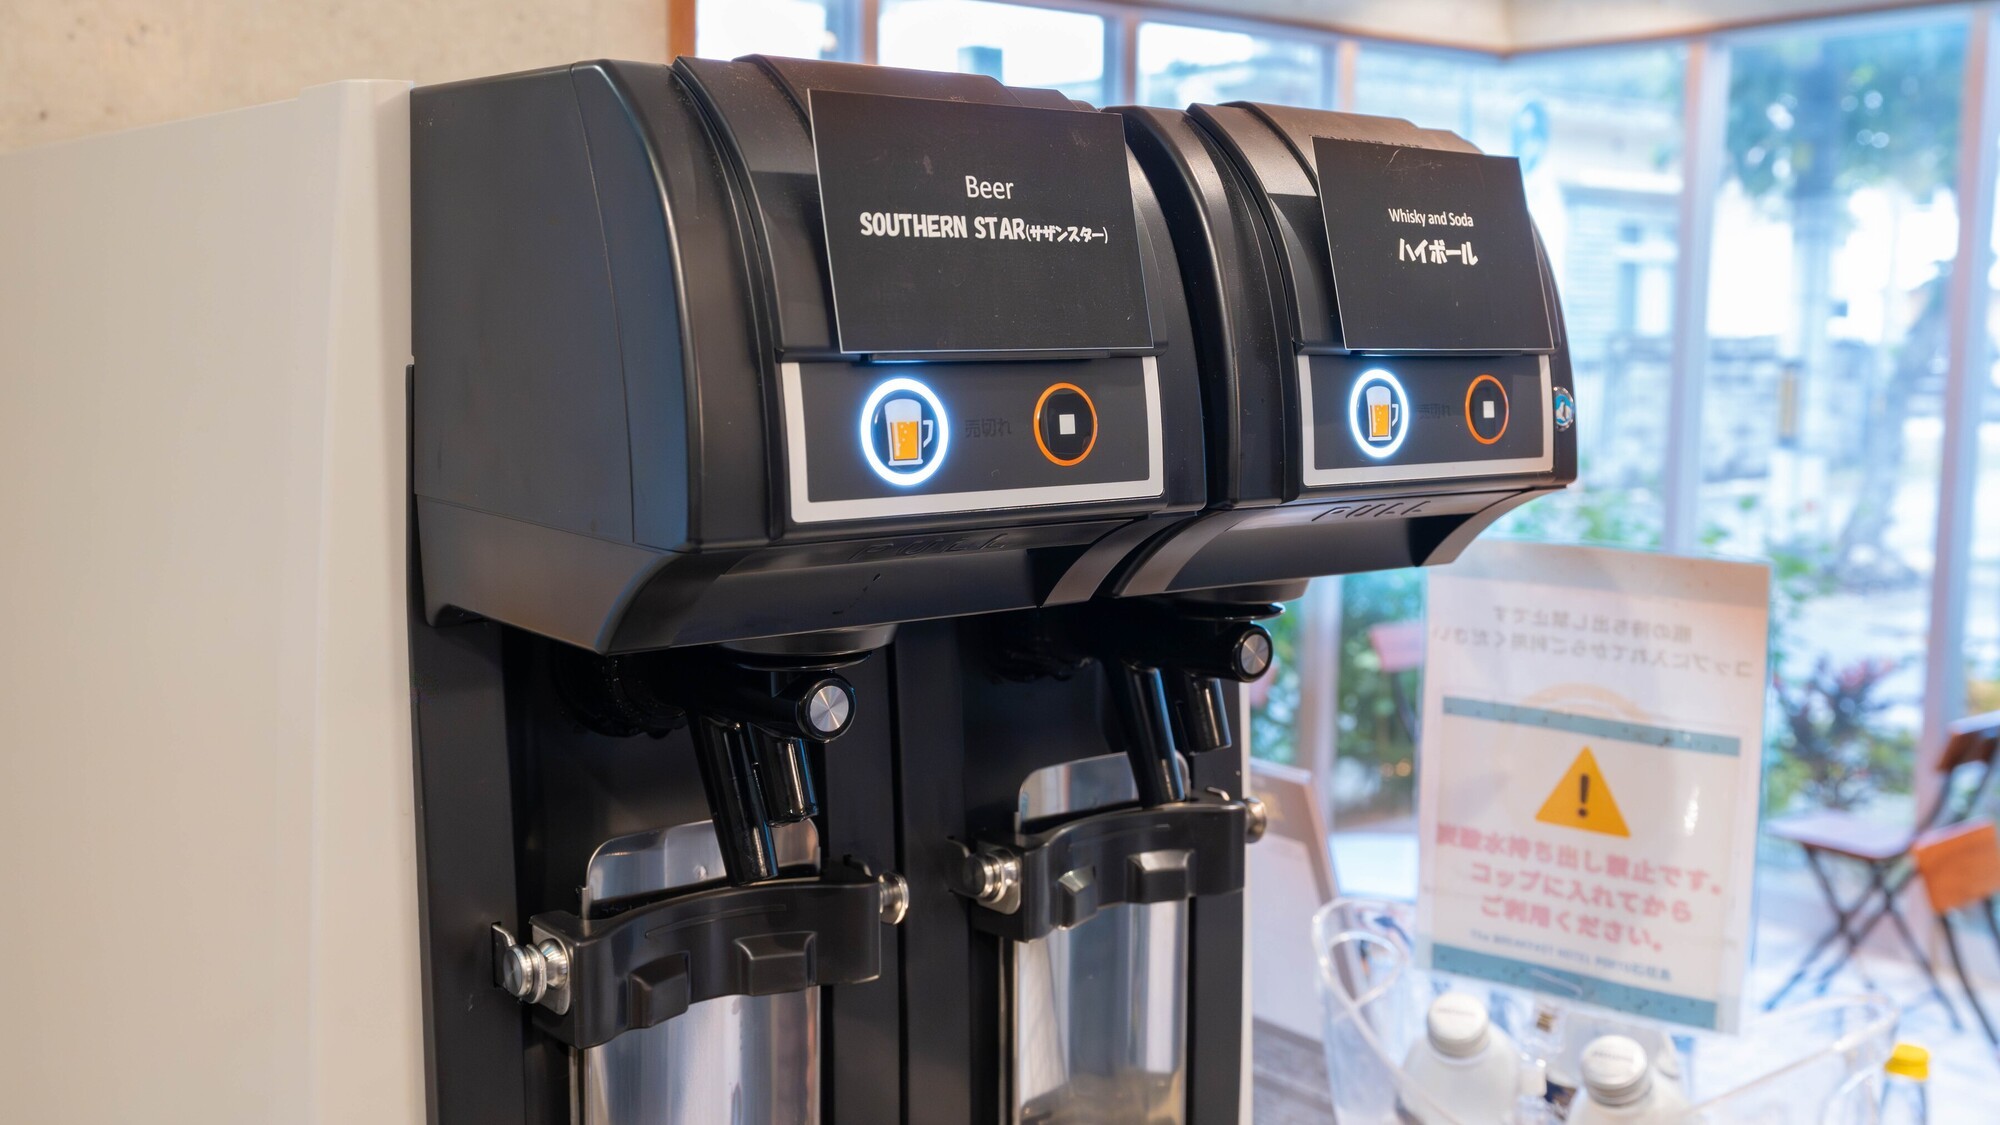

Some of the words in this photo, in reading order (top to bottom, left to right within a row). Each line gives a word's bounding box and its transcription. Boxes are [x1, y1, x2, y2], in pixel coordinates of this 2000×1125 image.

[965, 175, 1014, 200] Beer
[859, 212, 968, 238] SOUTHERN
[1388, 208, 1426, 227] Whisky
[1428, 210, 1447, 226] and
[1449, 212, 1474, 227] Soda
[1398, 238, 1479, 266] ハイボール
[1470, 861, 1693, 922] コップに入れてから
[1480, 895, 1663, 953] ご利用ください。
